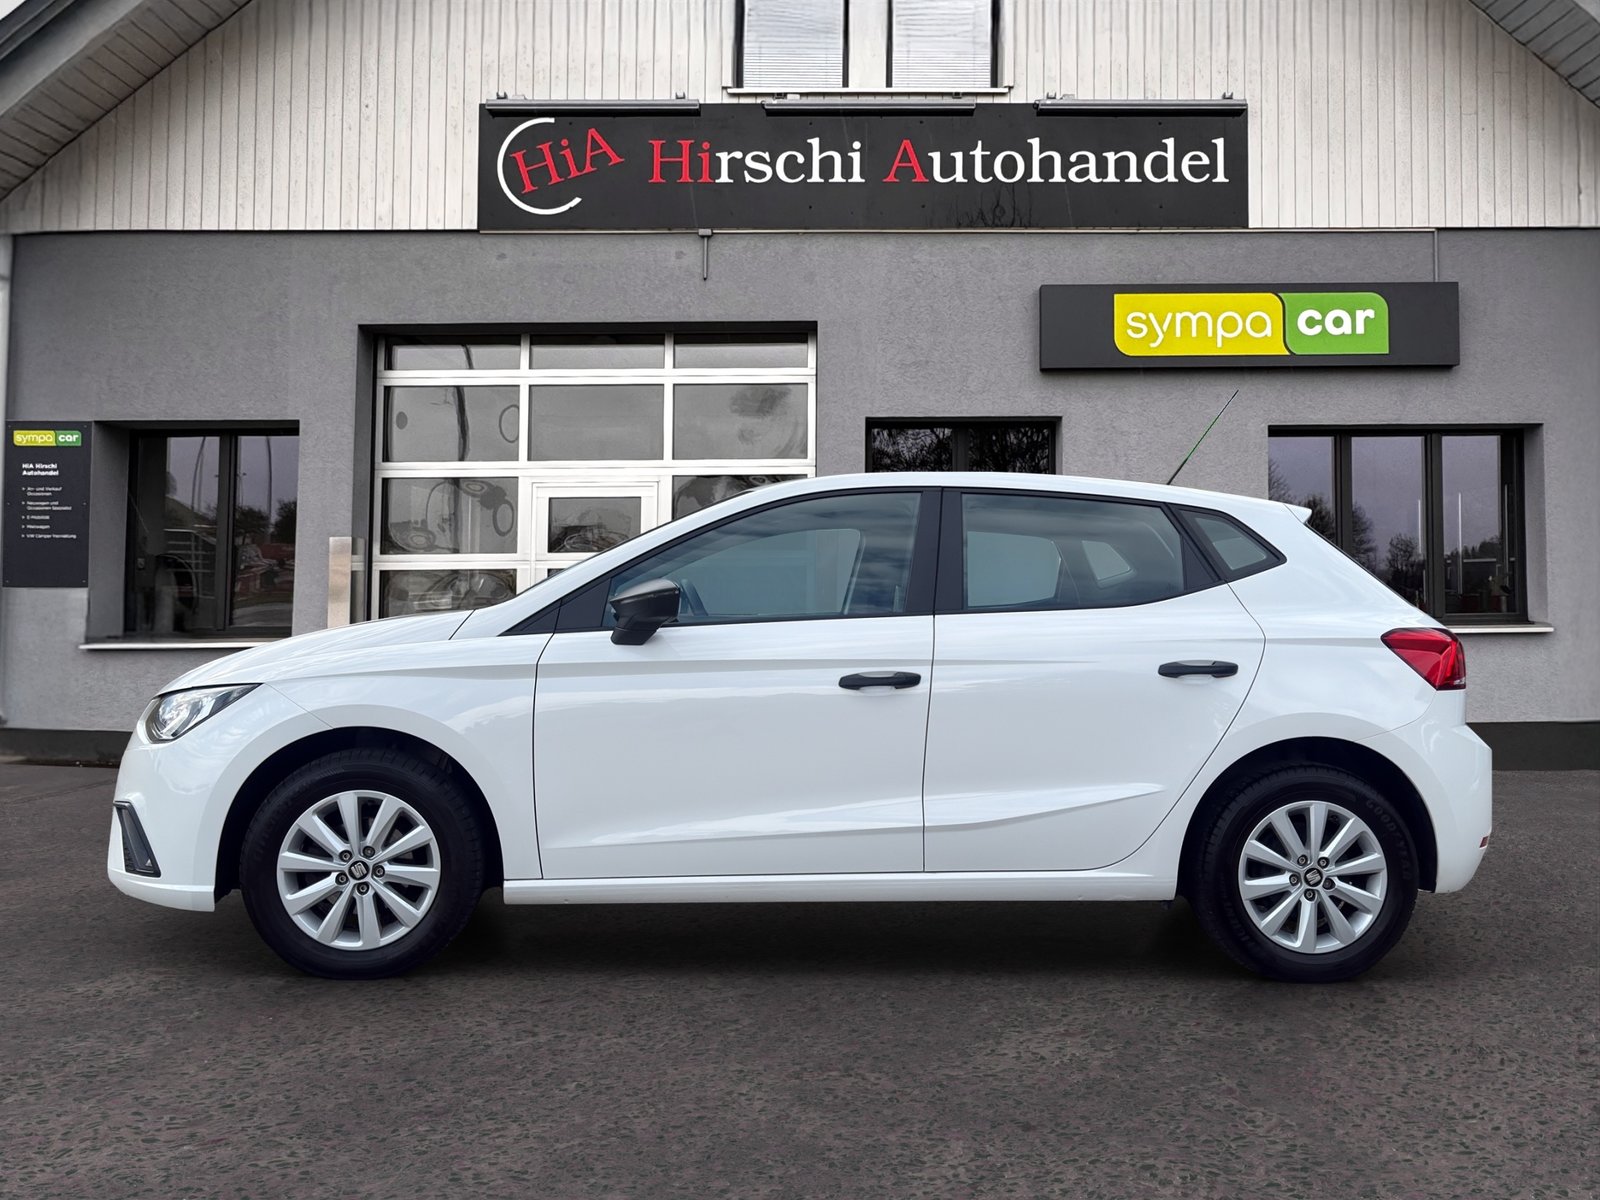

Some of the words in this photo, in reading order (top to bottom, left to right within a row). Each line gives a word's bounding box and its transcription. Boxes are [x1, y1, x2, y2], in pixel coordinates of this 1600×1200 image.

[509, 127, 624, 194] HiA
[648, 137, 866, 183] Hirschi
[882, 137, 1230, 183] Autohandel
[1126, 311, 1272, 348] sympa
[1297, 308, 1375, 336] car
[15, 434, 53, 444] sympa
[58, 434, 79, 442] car
